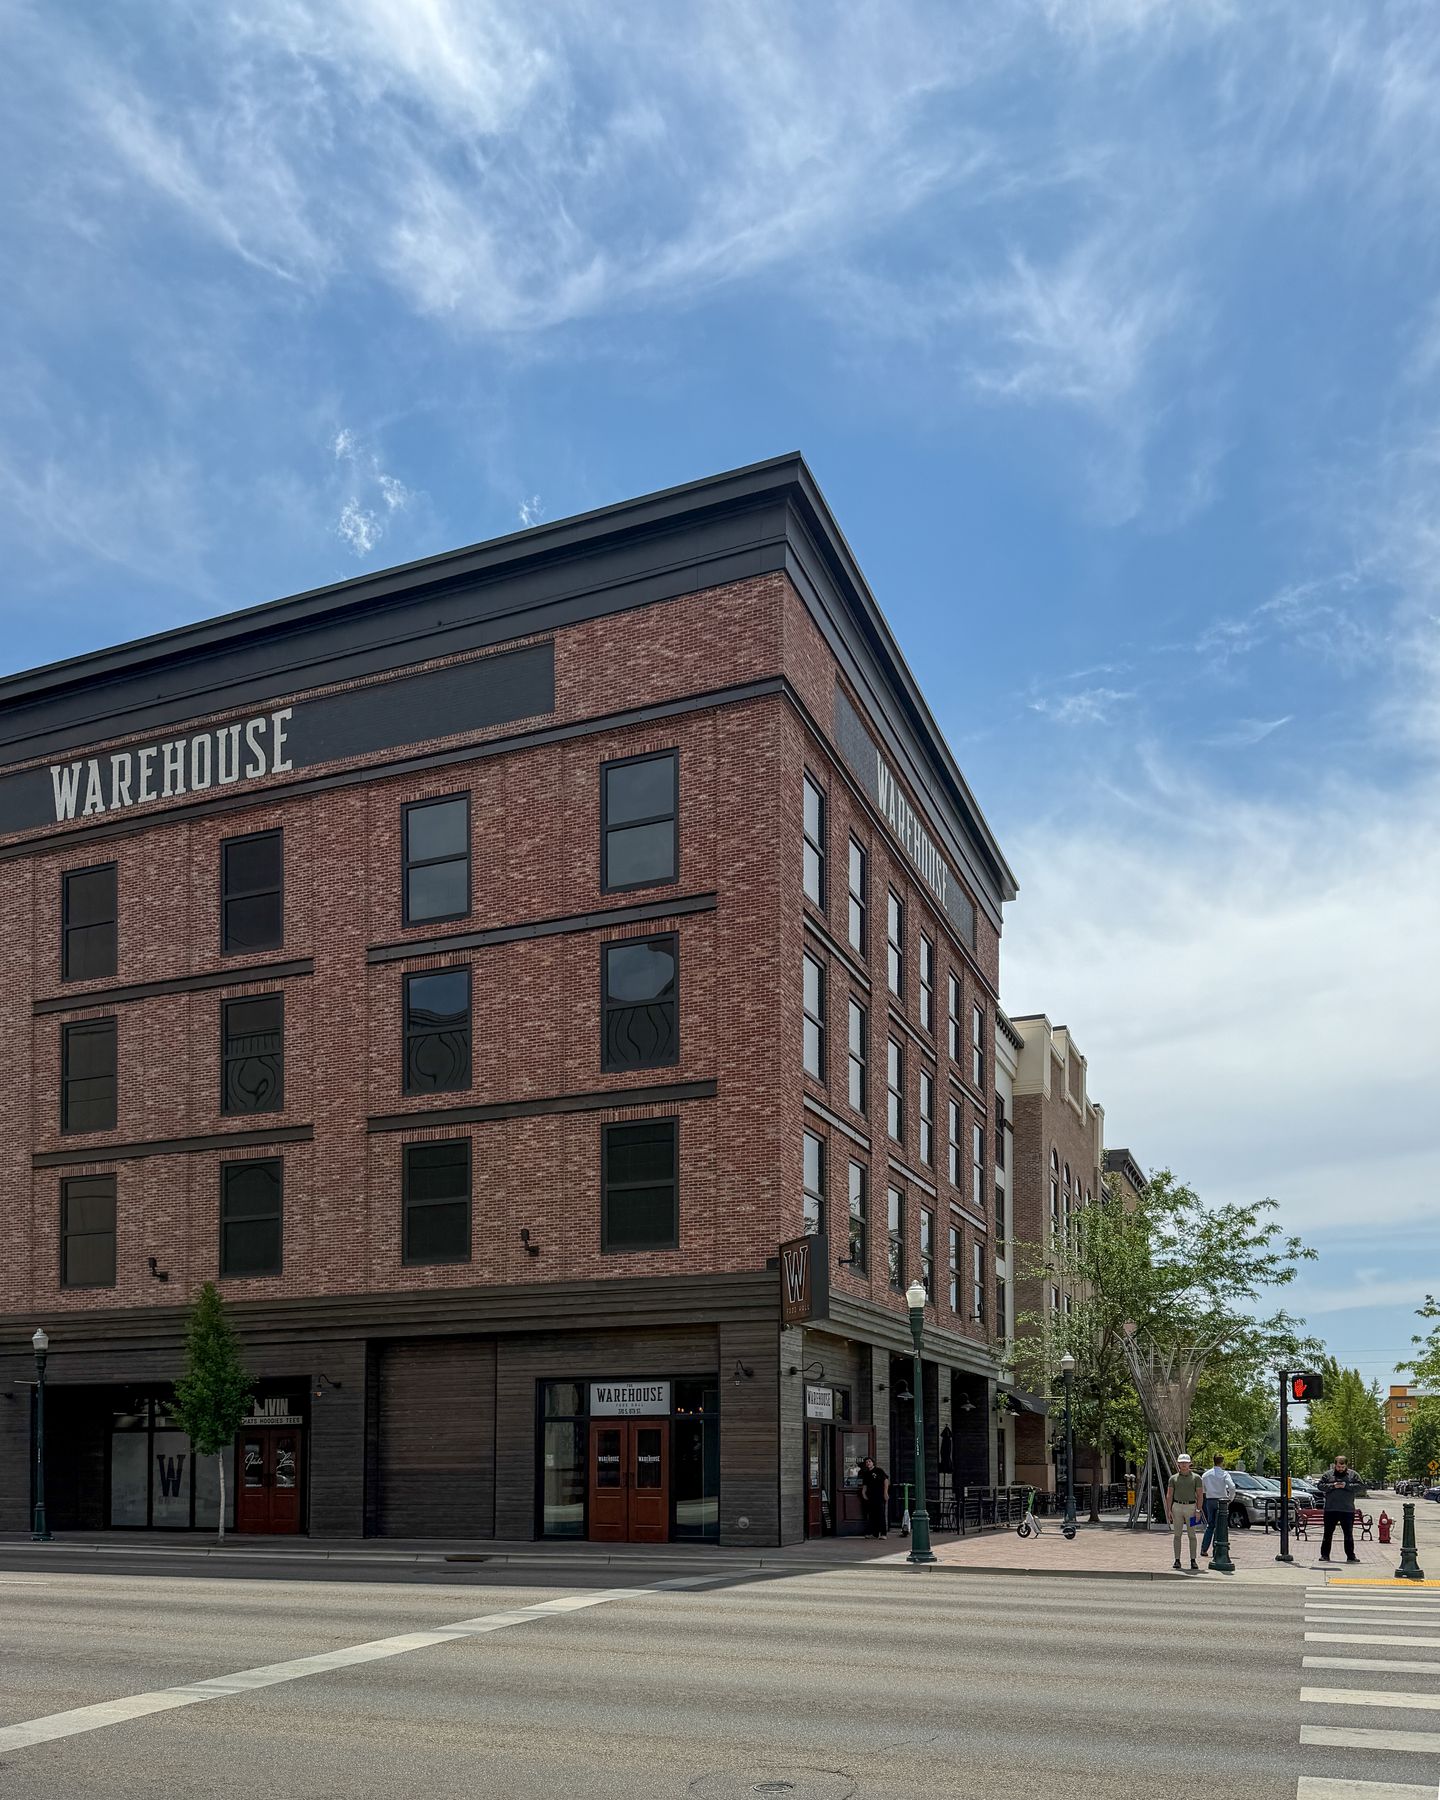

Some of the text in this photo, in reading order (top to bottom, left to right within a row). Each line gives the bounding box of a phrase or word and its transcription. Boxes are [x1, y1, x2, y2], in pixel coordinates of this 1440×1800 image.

[50, 708, 293, 822] WAREHOUSE
[876, 750, 949, 910] WAREHOUSE
[783, 1245, 808, 1303] W
[597, 1387, 663, 1403] WAREHOUSE
[808, 1391, 831, 1406] WAREHOUSE
[156, 1454, 186, 1498] W
